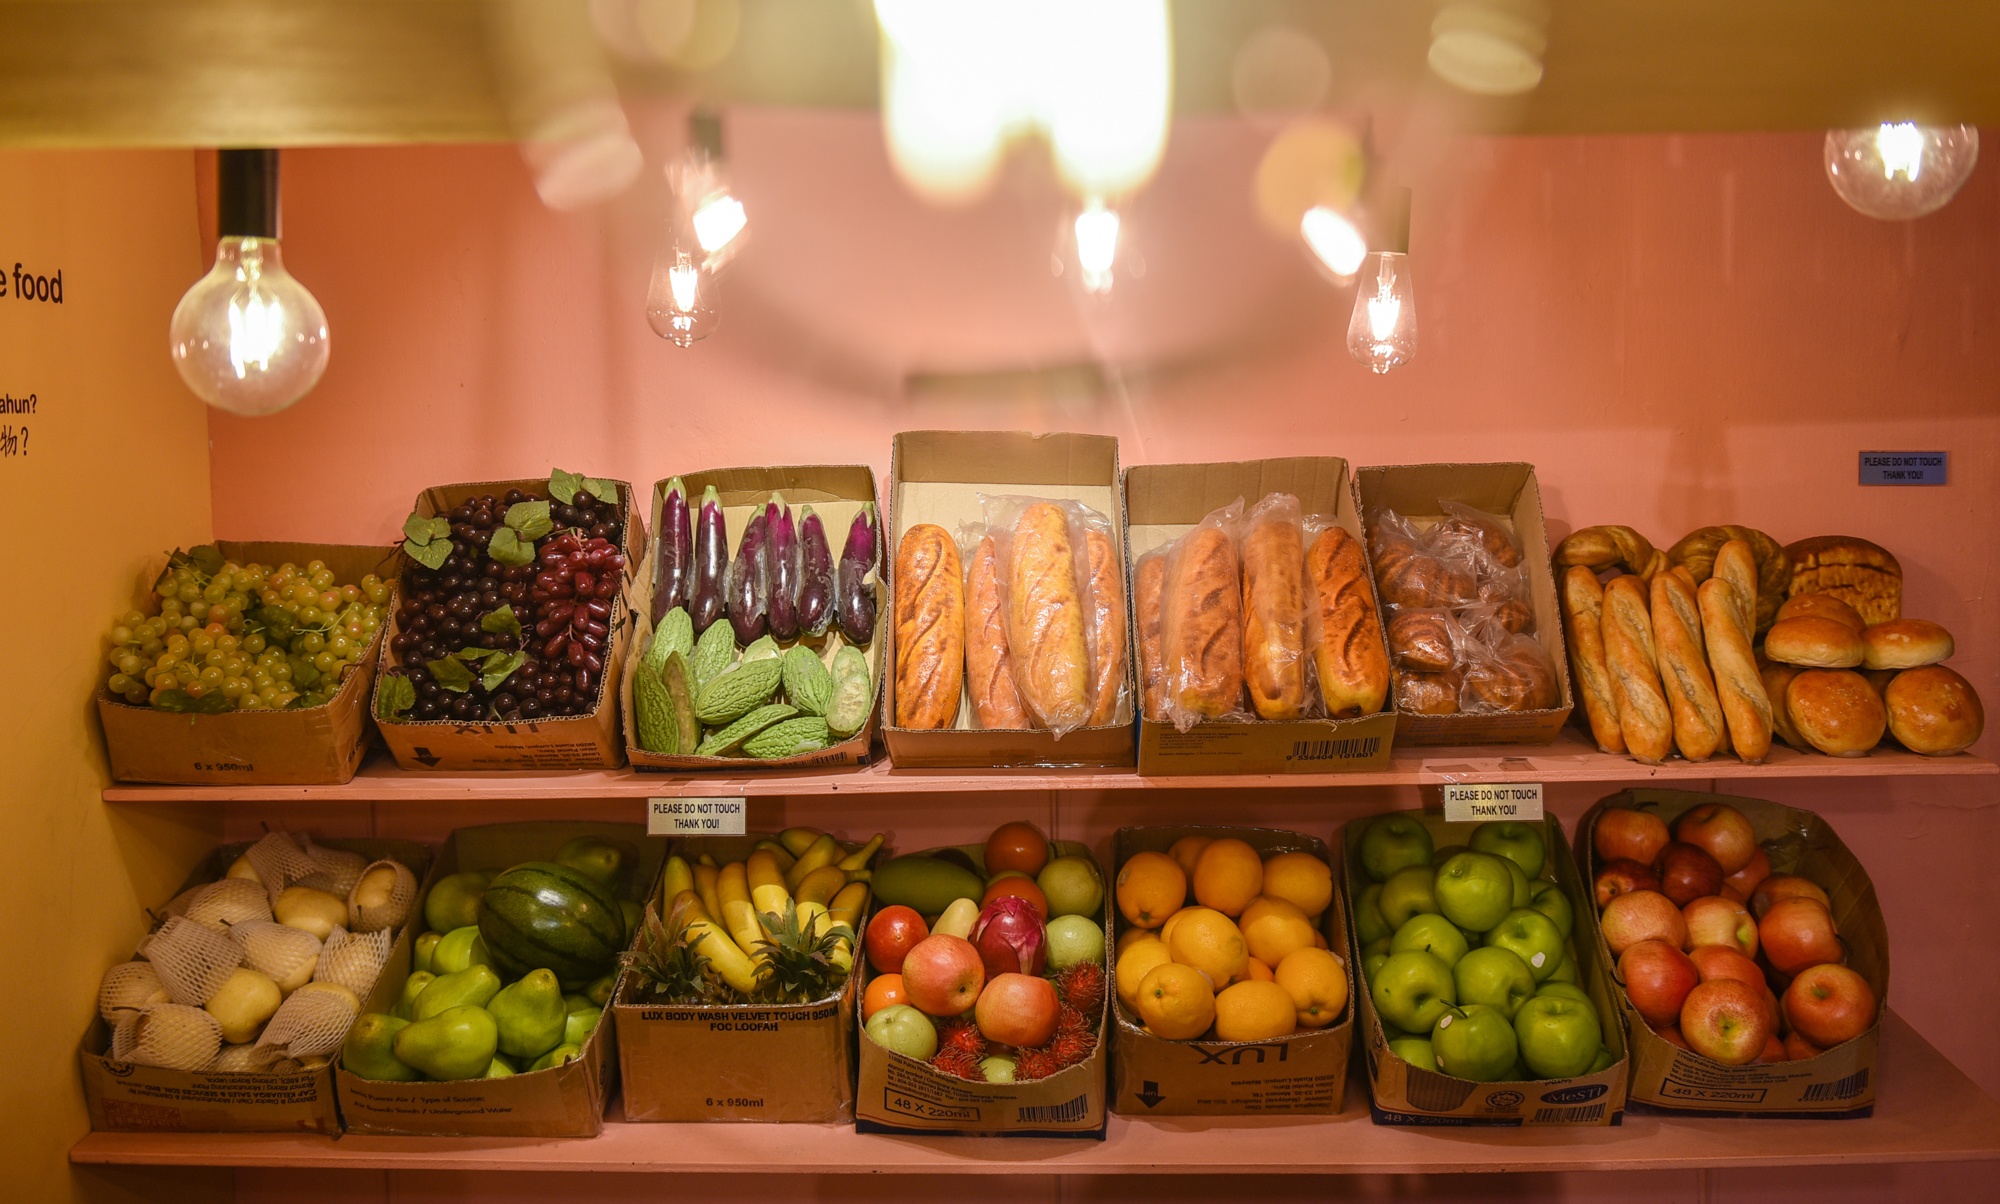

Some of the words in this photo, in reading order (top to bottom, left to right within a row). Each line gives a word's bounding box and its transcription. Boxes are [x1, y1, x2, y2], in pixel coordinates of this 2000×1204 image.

[12, 262, 63, 304] food
[1864, 457, 1890, 466] PLEASE
[1892, 457, 1902, 466] DO
[1904, 457, 1917, 466] NOT
[1920, 457, 1942, 466] TOUCH
[1883, 470, 1906, 479] THANK
[1907, 470, 1924, 479] YOU!
[194, 762, 202, 771] 6
[216, 763, 254, 772] 950ml
[1450, 790, 1479, 800] PLEASE
[1482, 790, 1492, 800] DO
[1494, 790, 1509, 800] NOT
[1511, 790, 1537, 800] TOUCH
[654, 804, 682, 813] PLEASE
[684, 804, 695, 813] DO
[698, 804, 712, 813] NOT
[714, 804, 740, 813] TOUCH
[1471, 806, 1497, 815] THANK
[1499, 805, 1516, 814] YOU!
[674, 818, 700, 828] THANK
[702, 818, 720, 828] YOU!
[642, 1011, 663, 1020] LUX
[666, 1011, 695, 1020] BODY
[698, 1011, 728, 1020] WASH
[731, 1011, 771, 1020] VELVET
[774, 1010, 810, 1021] TOUCH
[710, 1022, 732, 1032] FOC
[734, 1022, 778, 1032] LOOFAH
[1188, 1043, 1288, 1065] LUX
[181, 1096, 230, 1104] Manufactured
[368, 1094, 394, 1102] Punca
[1548, 1088, 1602, 1102] MeSTI
[1710, 1091, 1755, 1100] 220ml
[706, 1098, 713, 1106] 6
[727, 1098, 764, 1107] 950ml
[894, 1097, 911, 1111] 48
[914, 1102, 924, 1114] X
[928, 1106, 970, 1118] 220ml
[366, 1103, 394, 1113] Bawah
[429, 1107, 484, 1116] Underground
[1384, 1114, 1402, 1122] 48
